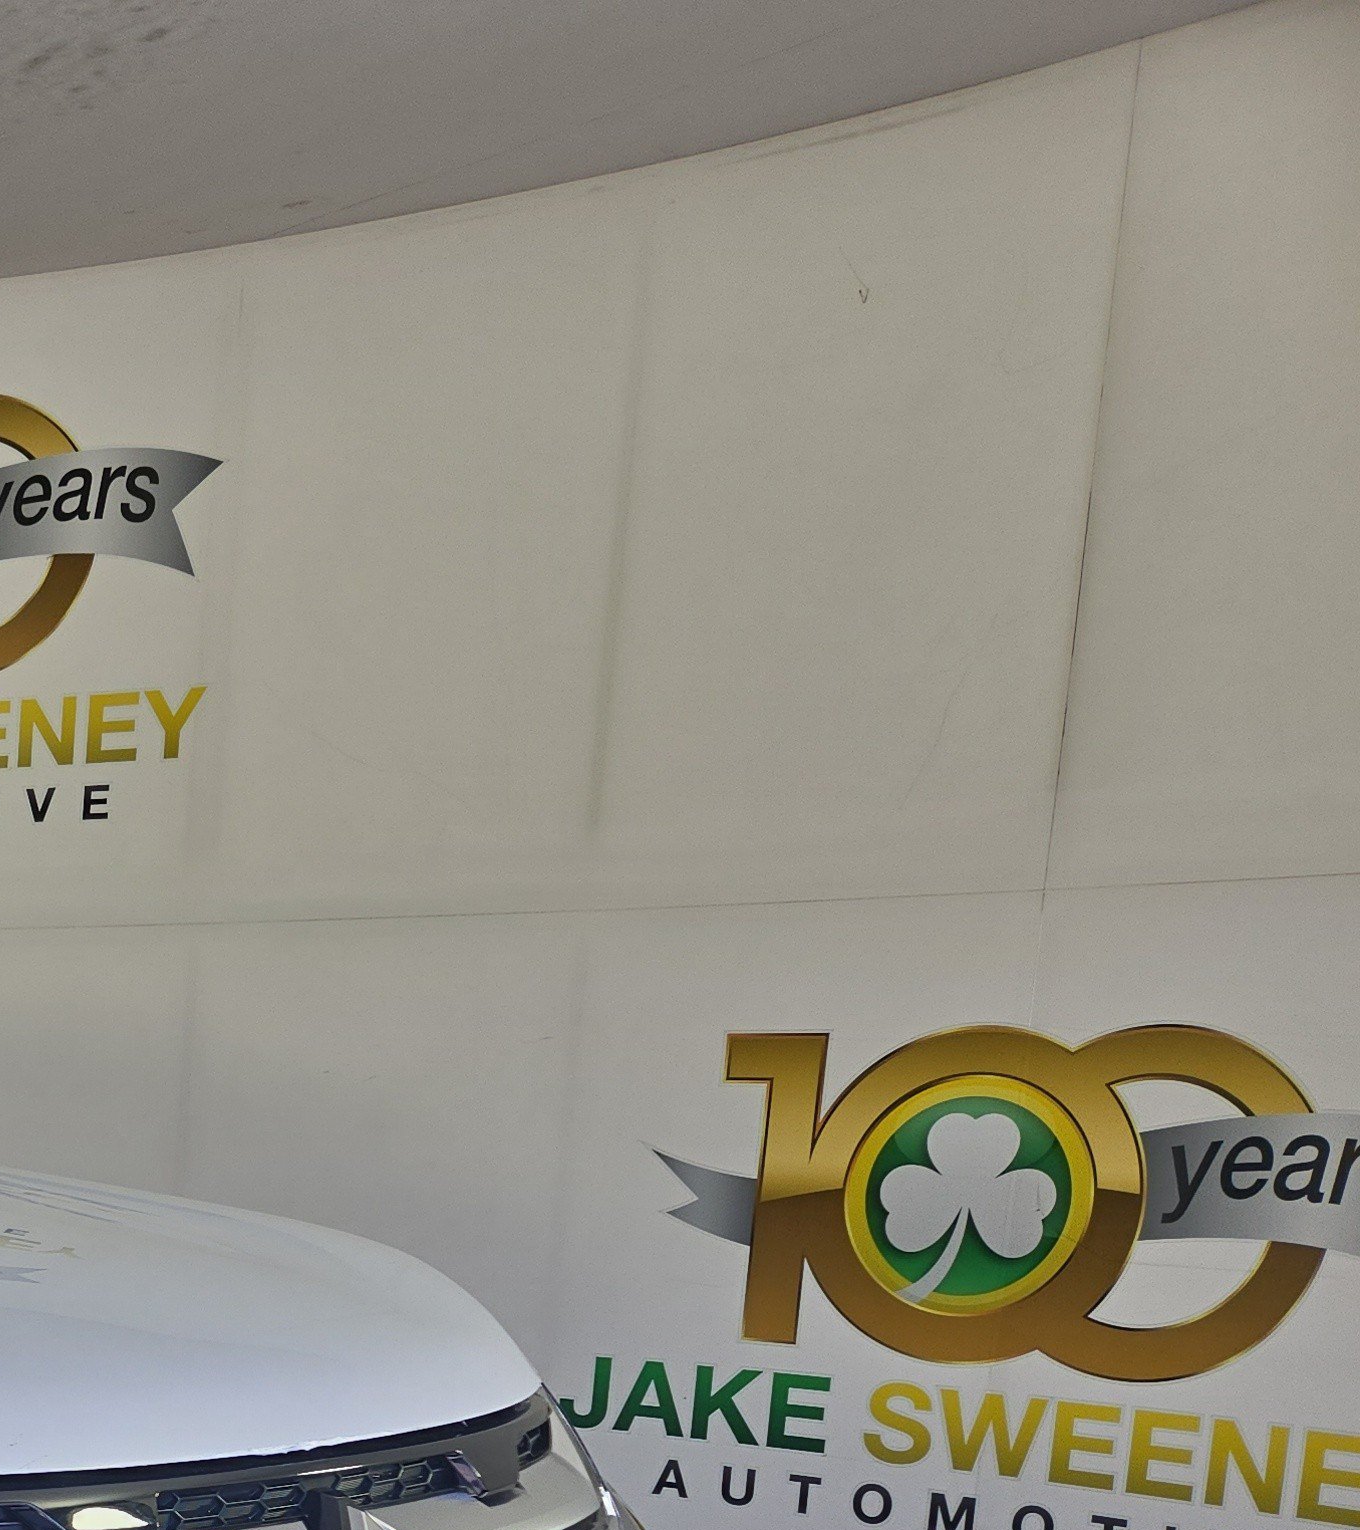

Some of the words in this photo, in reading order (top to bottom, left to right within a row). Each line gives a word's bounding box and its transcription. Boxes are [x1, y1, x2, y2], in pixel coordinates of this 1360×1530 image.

[1160, 1132, 1360, 1224] year
[559, 1356, 832, 1453] JAKE
[863, 1382, 1360, 1527] SWEENE
